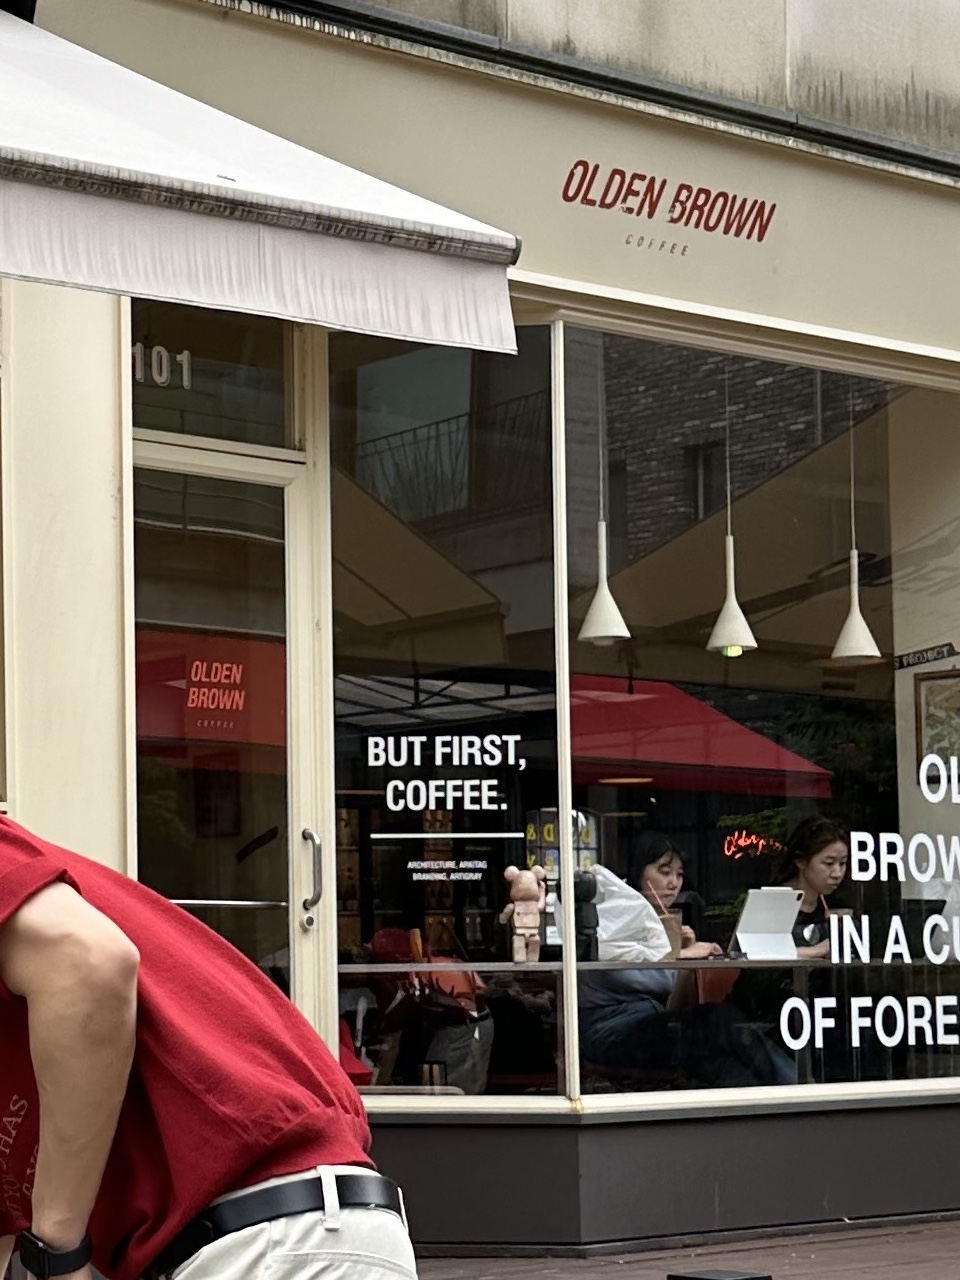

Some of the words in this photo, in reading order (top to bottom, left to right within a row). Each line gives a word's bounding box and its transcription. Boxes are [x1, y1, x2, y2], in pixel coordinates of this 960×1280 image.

[561, 159, 668, 220] OLDEN
[666, 183, 777, 243] BROWN
[624, 233, 690, 257] COFFEE
[132, 342, 192, 390] 101
[191, 660, 243, 684] OLDEN
[187, 687, 246, 710] BROWN
[367, 736, 427, 767] BUT
[435, 734, 527, 771] FIRST,
[386, 779, 508, 811] COFFEE.
[830, 914, 870, 964] IN
[883, 915, 912, 964] A
[780, 997, 836, 1050] OF
[851, 995, 960, 1048] FORE
